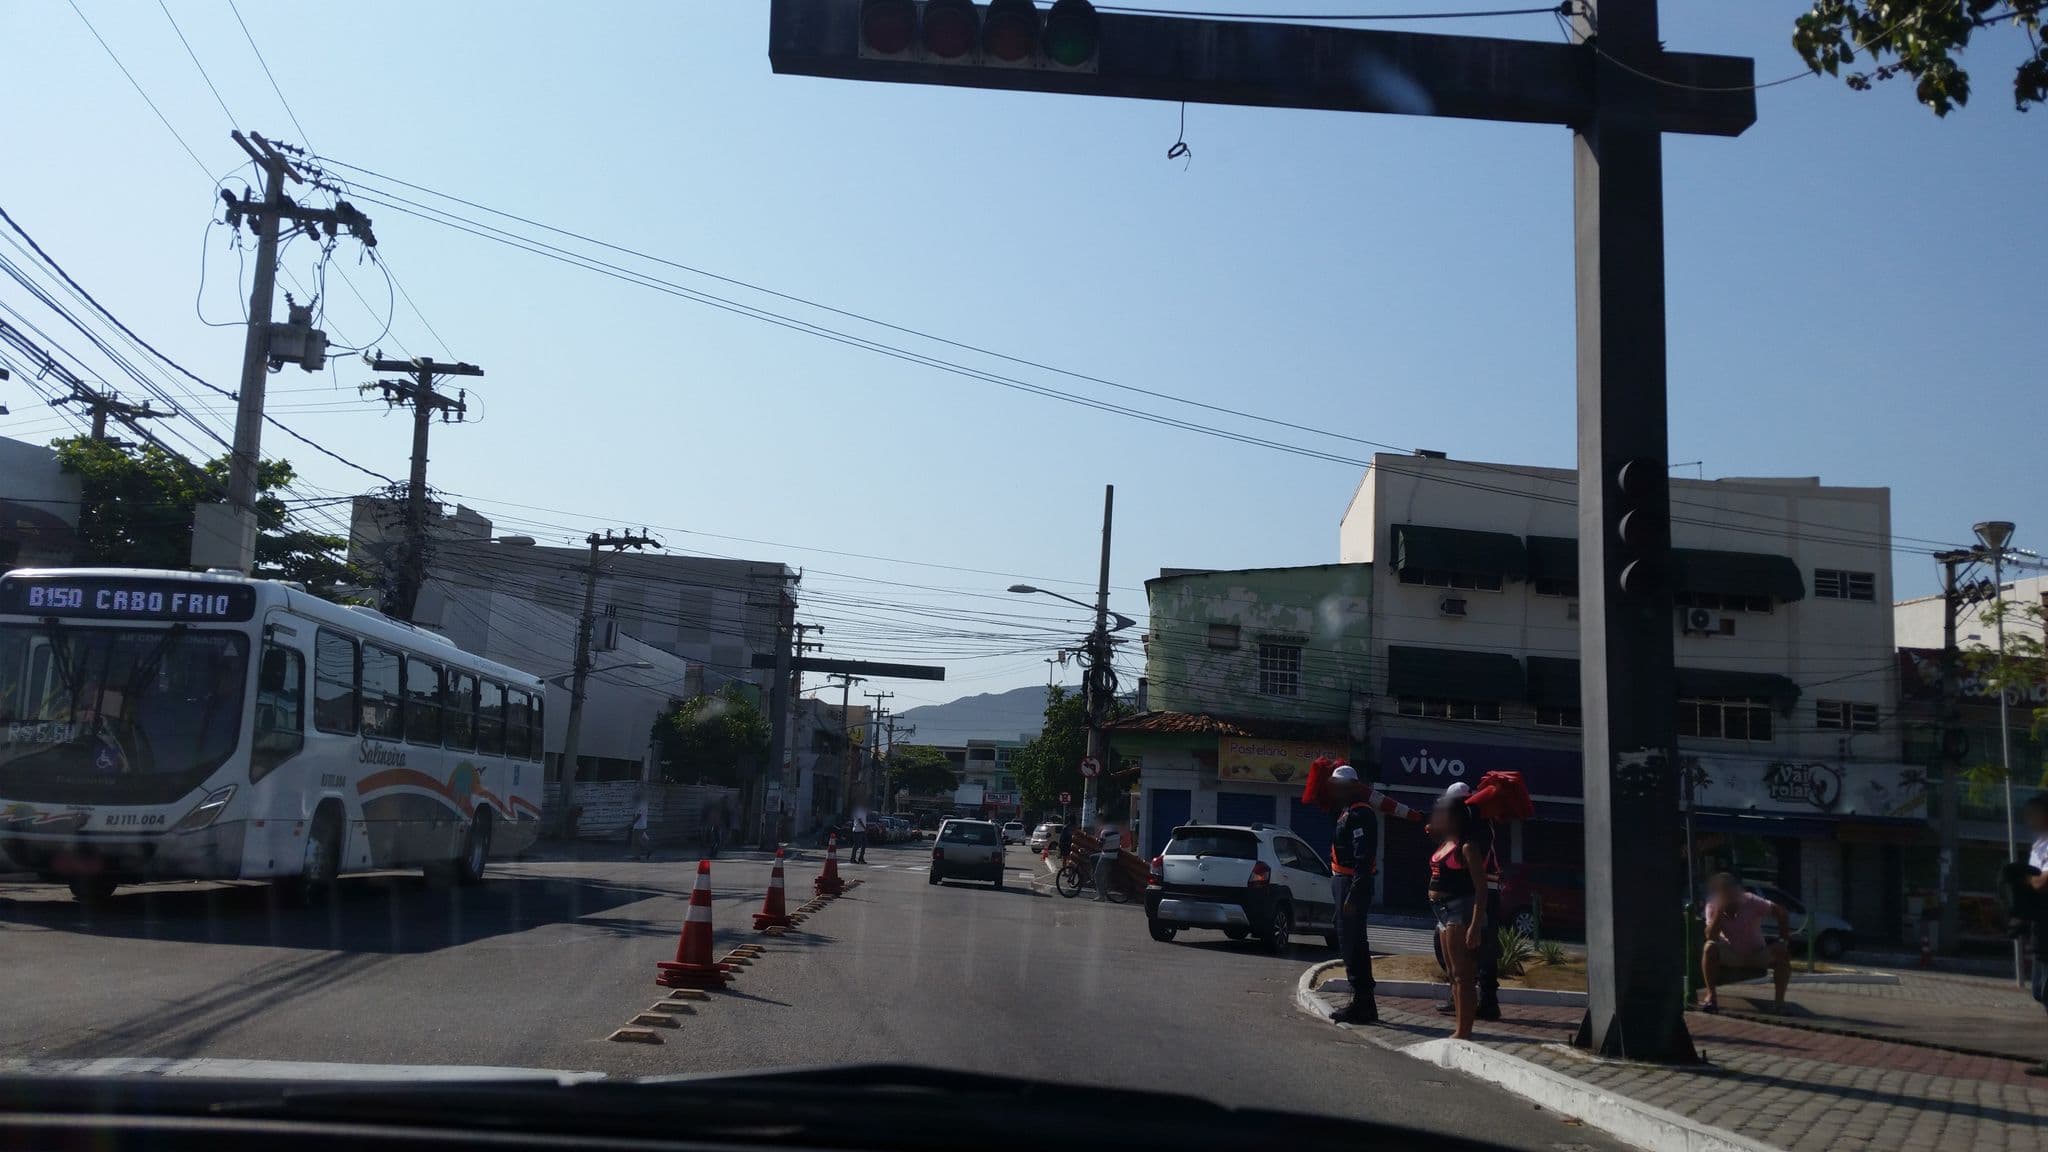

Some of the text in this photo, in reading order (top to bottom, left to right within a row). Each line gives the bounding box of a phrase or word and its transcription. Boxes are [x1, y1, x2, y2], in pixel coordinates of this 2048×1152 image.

[96, 590, 163, 611] CABO
[171, 594, 229, 614] FRIO
[1400, 748, 1465, 776] vivo
